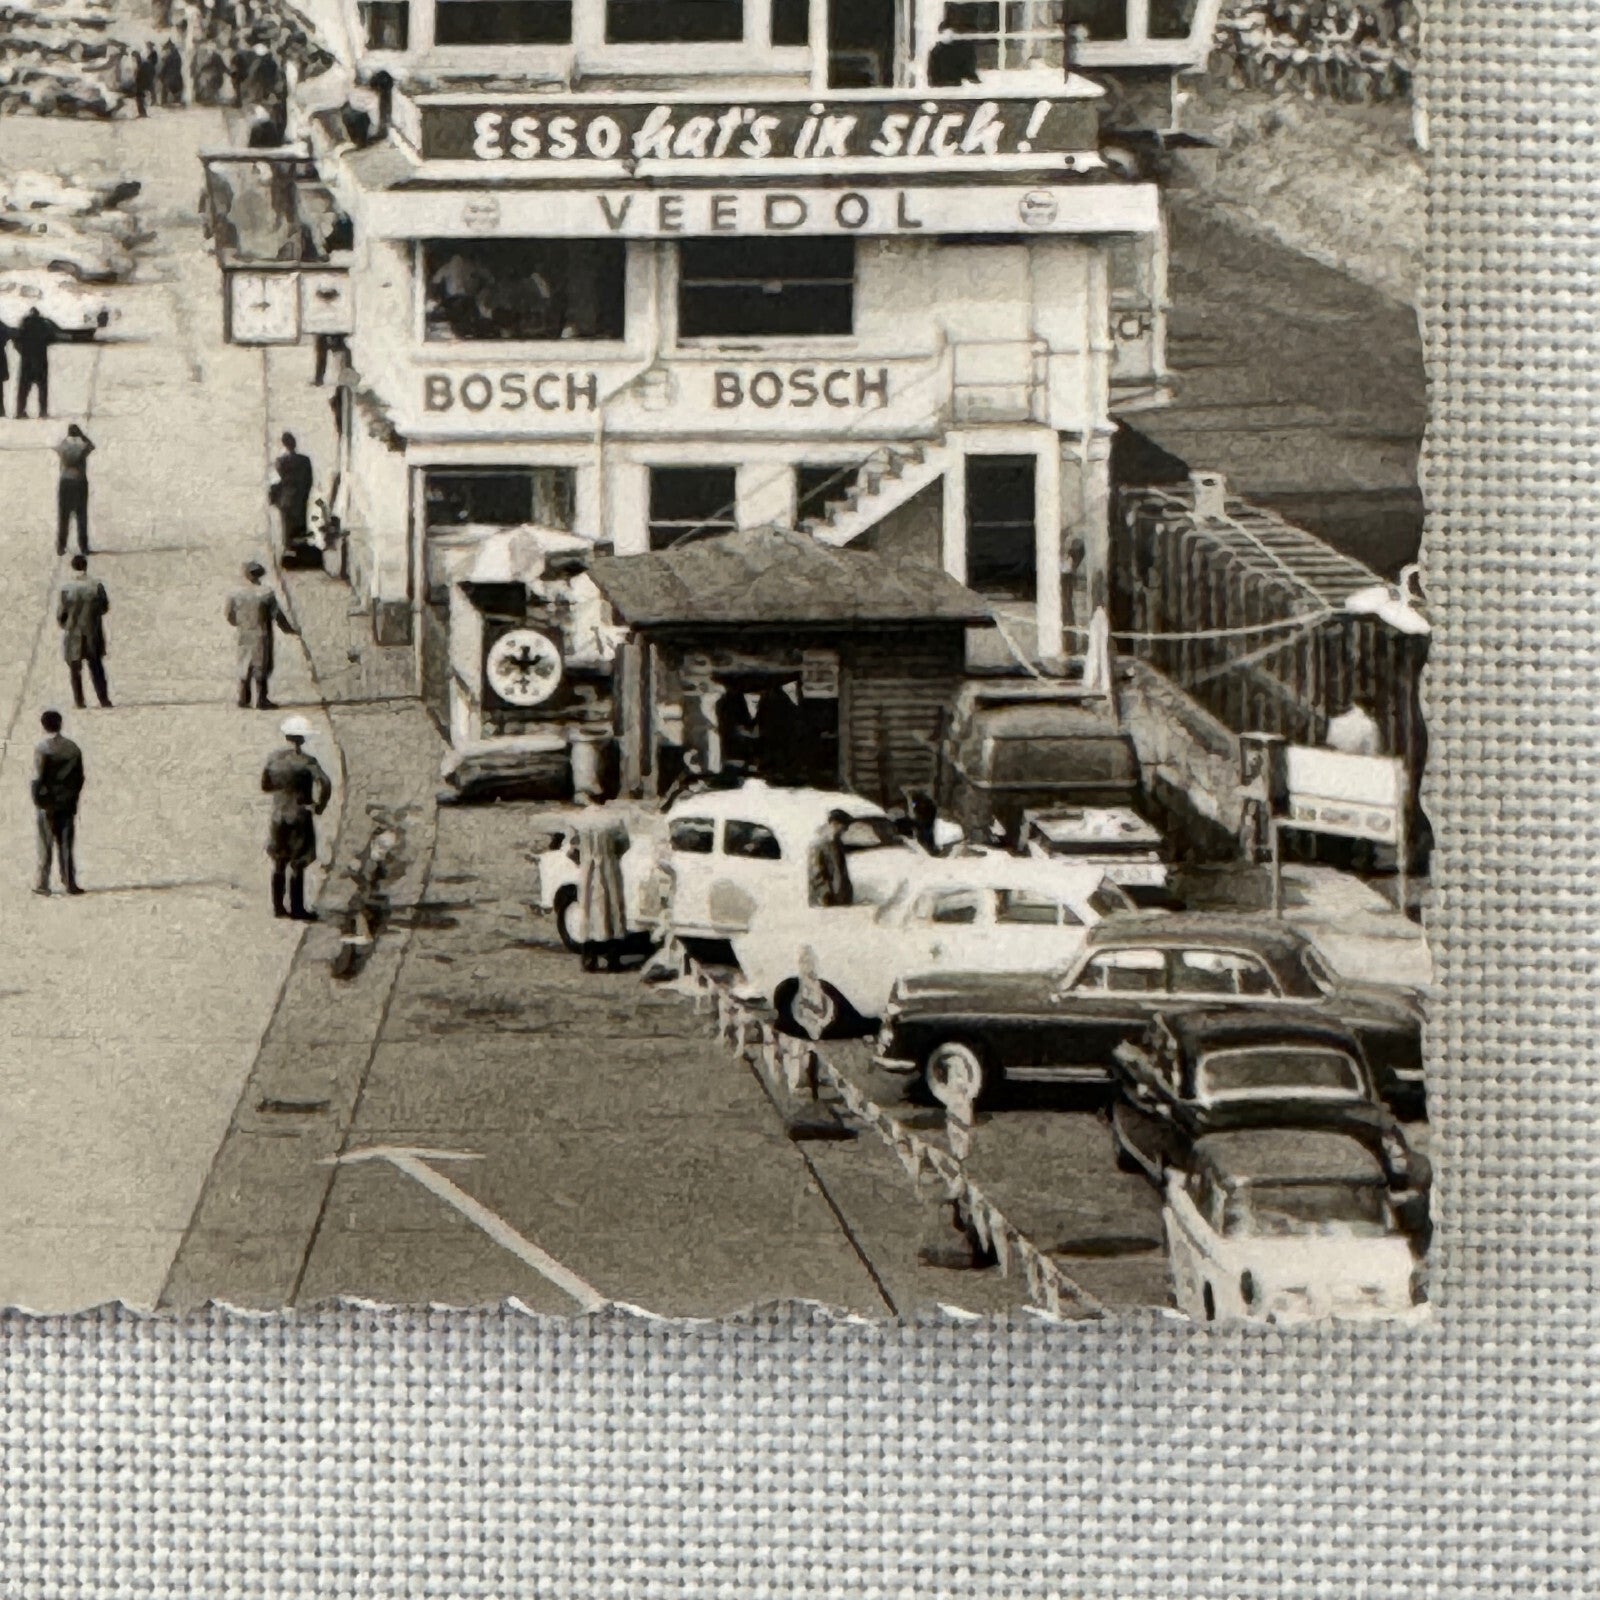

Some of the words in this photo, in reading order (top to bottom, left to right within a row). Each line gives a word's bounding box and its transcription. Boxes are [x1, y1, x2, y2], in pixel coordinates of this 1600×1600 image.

[598, 192, 924, 231] VEEDOL
[424, 373, 598, 411] BOSCH
[714, 368, 888, 408] BOSCH
